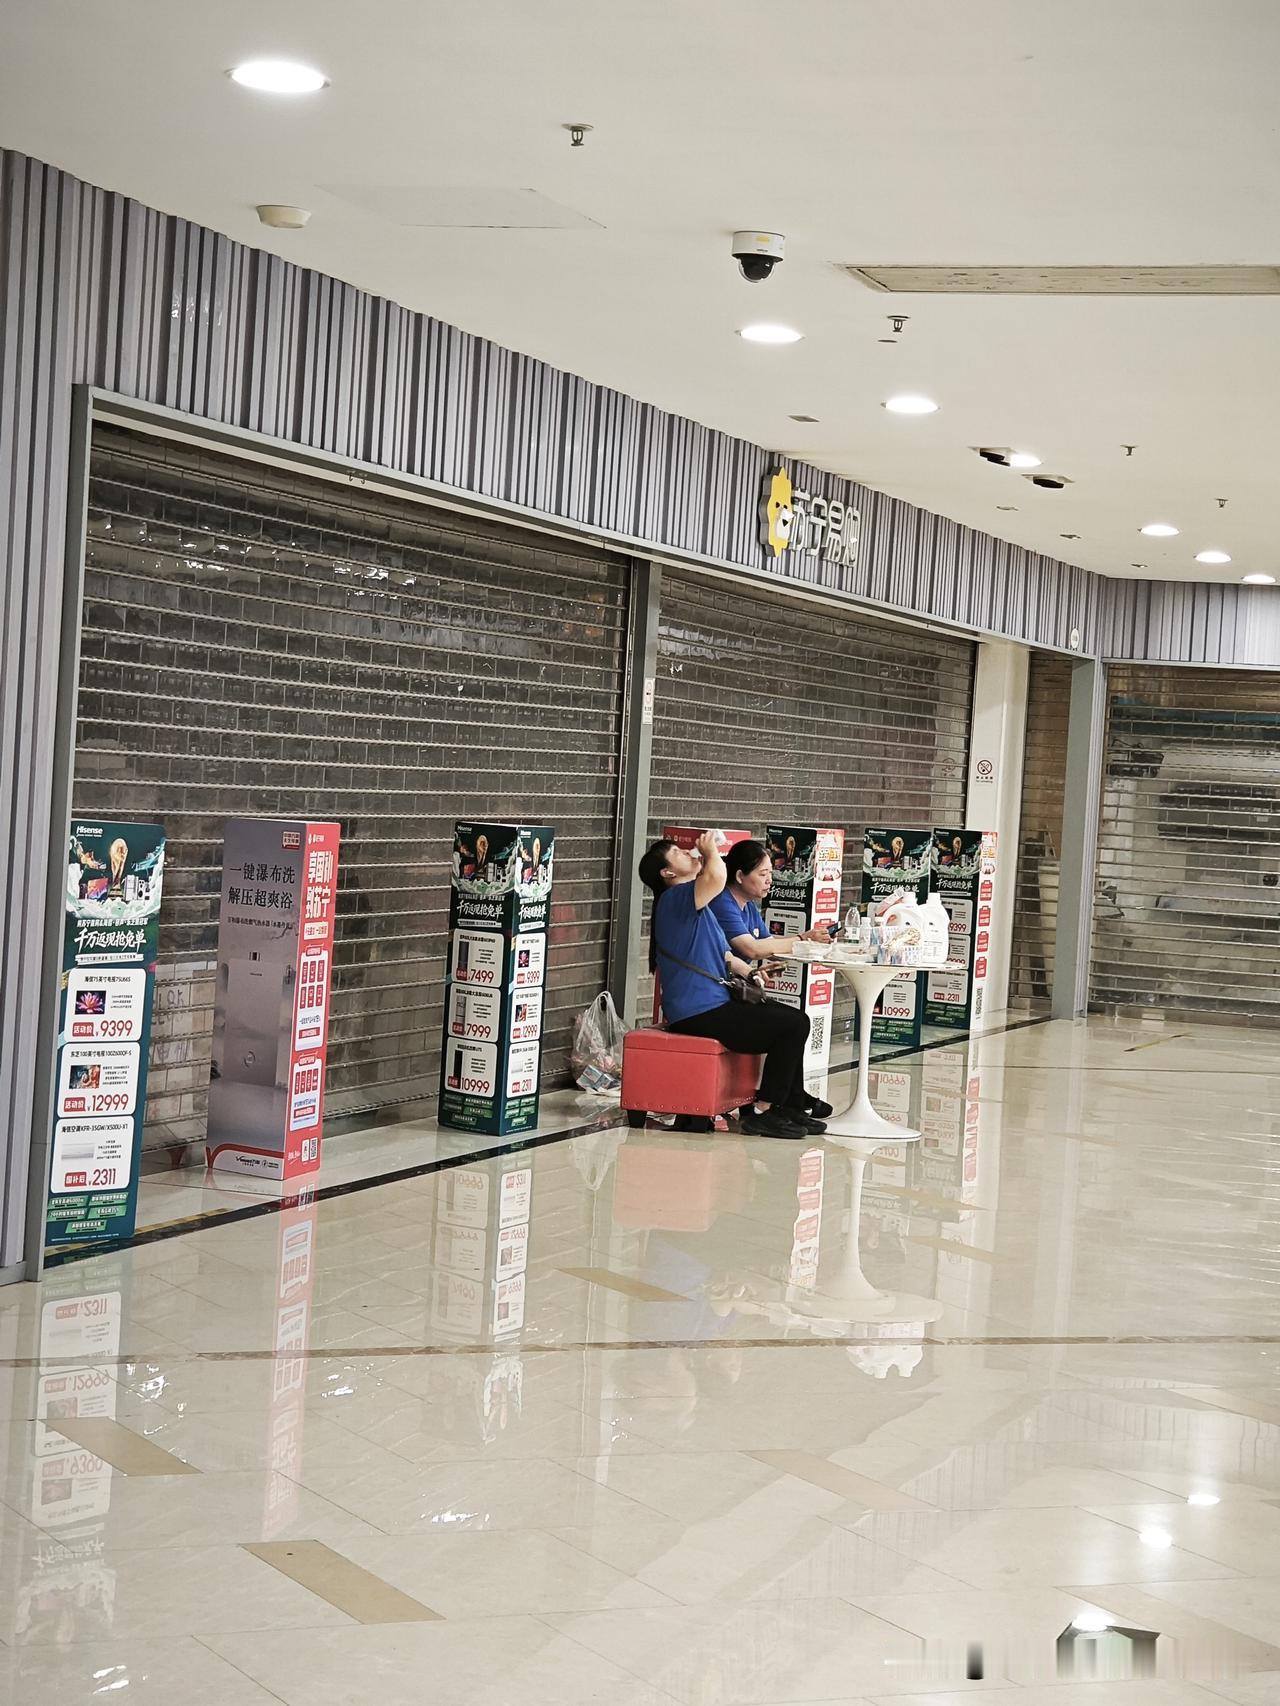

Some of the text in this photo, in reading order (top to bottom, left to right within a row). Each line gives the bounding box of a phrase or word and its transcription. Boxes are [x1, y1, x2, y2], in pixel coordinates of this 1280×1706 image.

[77, 826, 103, 837] Hisense
[229, 861, 296, 885] 一键瀑布洗
[227, 886, 293, 910] 解压超爽浴
[74, 928, 147, 954] 千万返现抢免单
[883, 1005, 911, 1017] 10999
